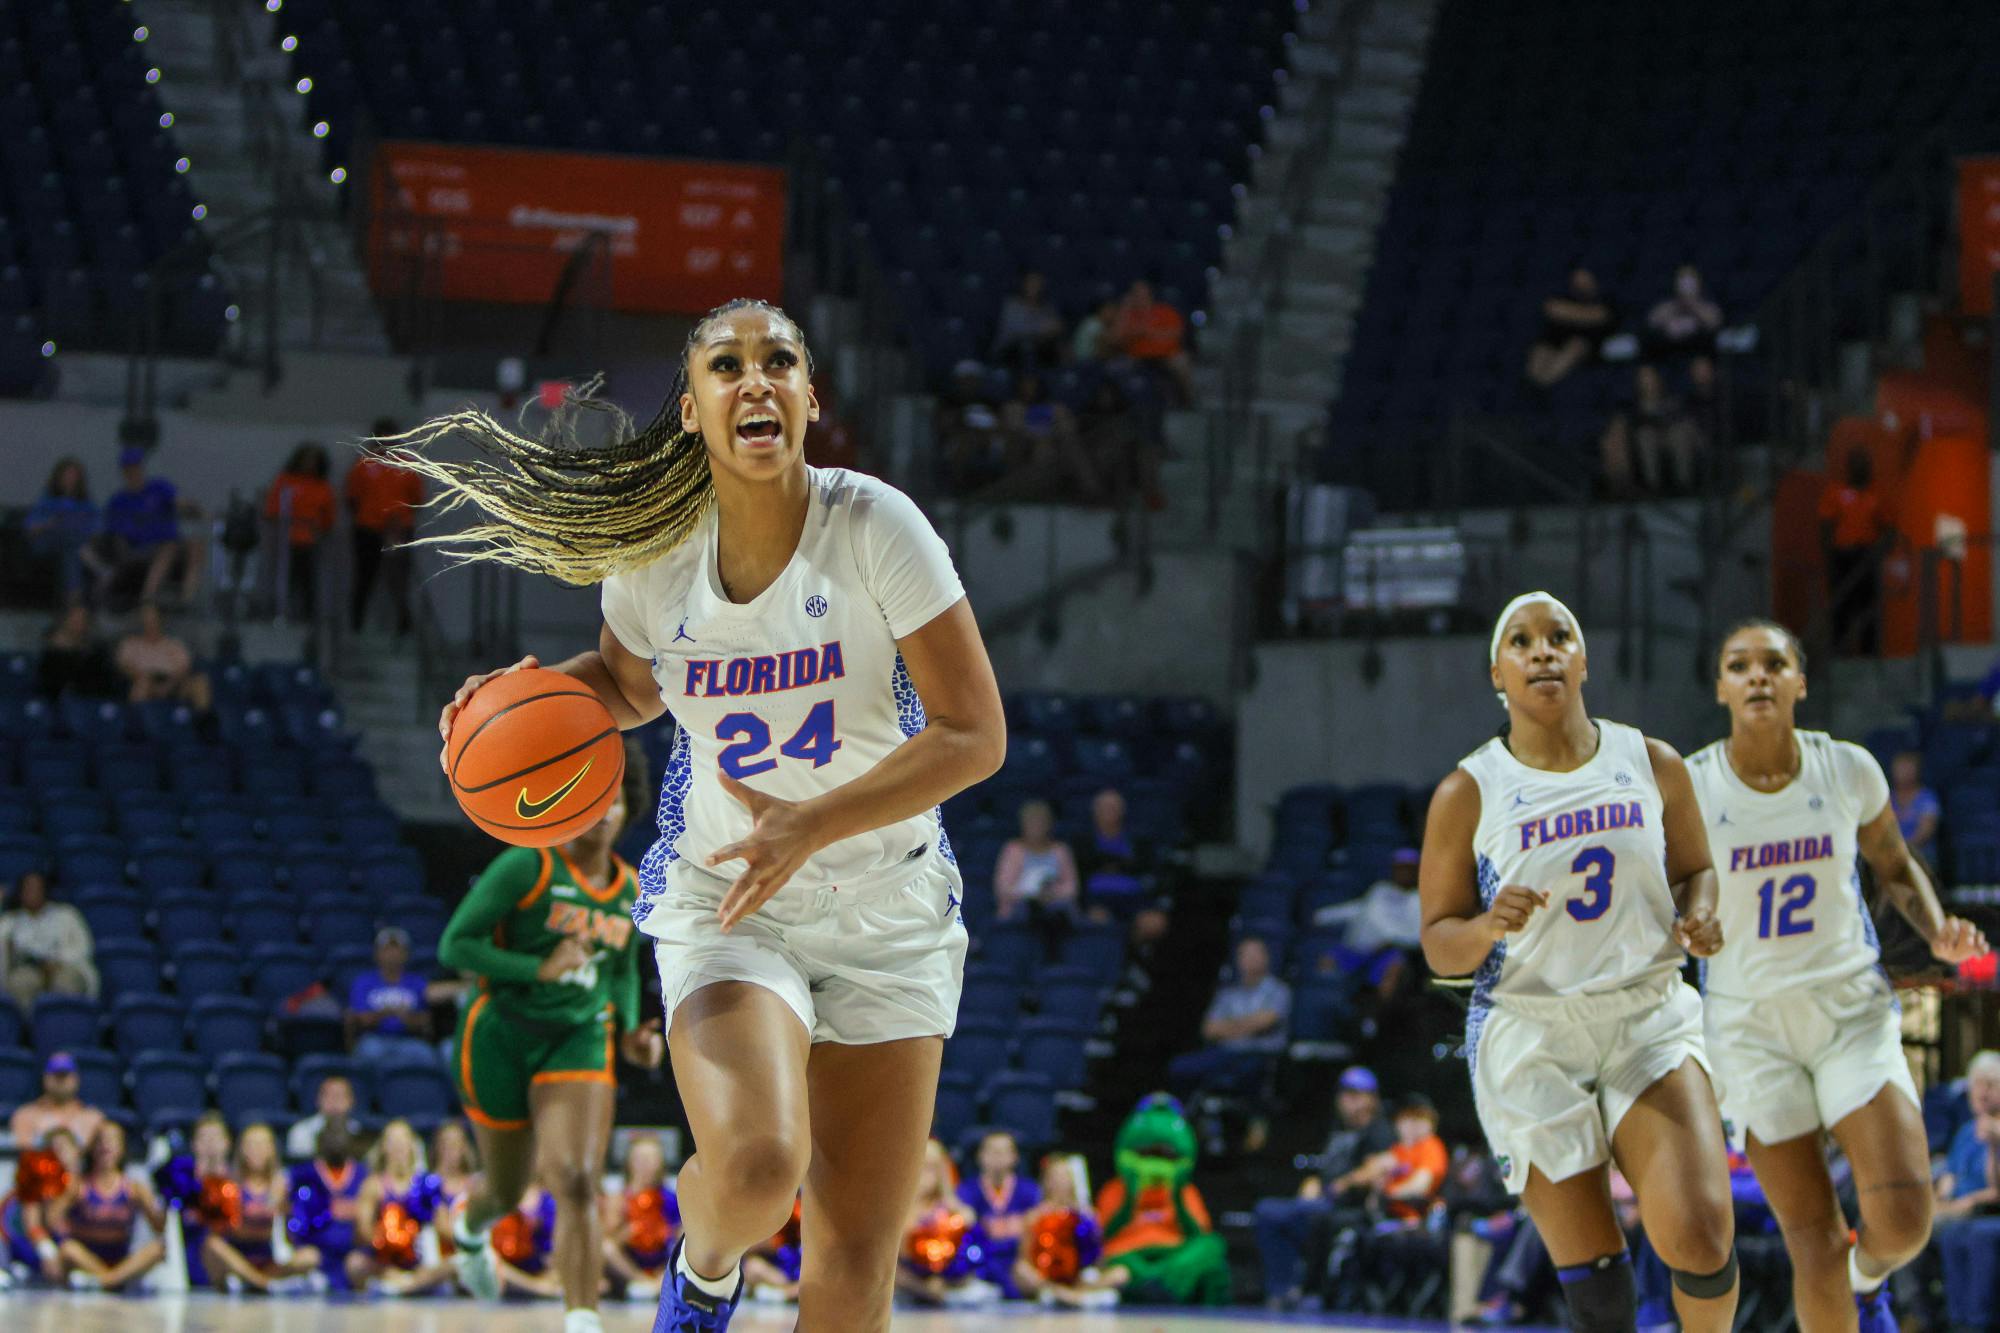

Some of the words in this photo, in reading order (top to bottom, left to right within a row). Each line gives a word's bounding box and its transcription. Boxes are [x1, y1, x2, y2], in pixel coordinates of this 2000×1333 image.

[805, 595, 828, 618] SEC
[683, 640, 846, 698] FLORIDA
[714, 698, 843, 781] 24
[1519, 801, 1645, 851] FLORIDA
[1729, 834, 1834, 873] FLORIDA
[1566, 845, 1616, 923] 3
[1757, 873, 1817, 940] 12
